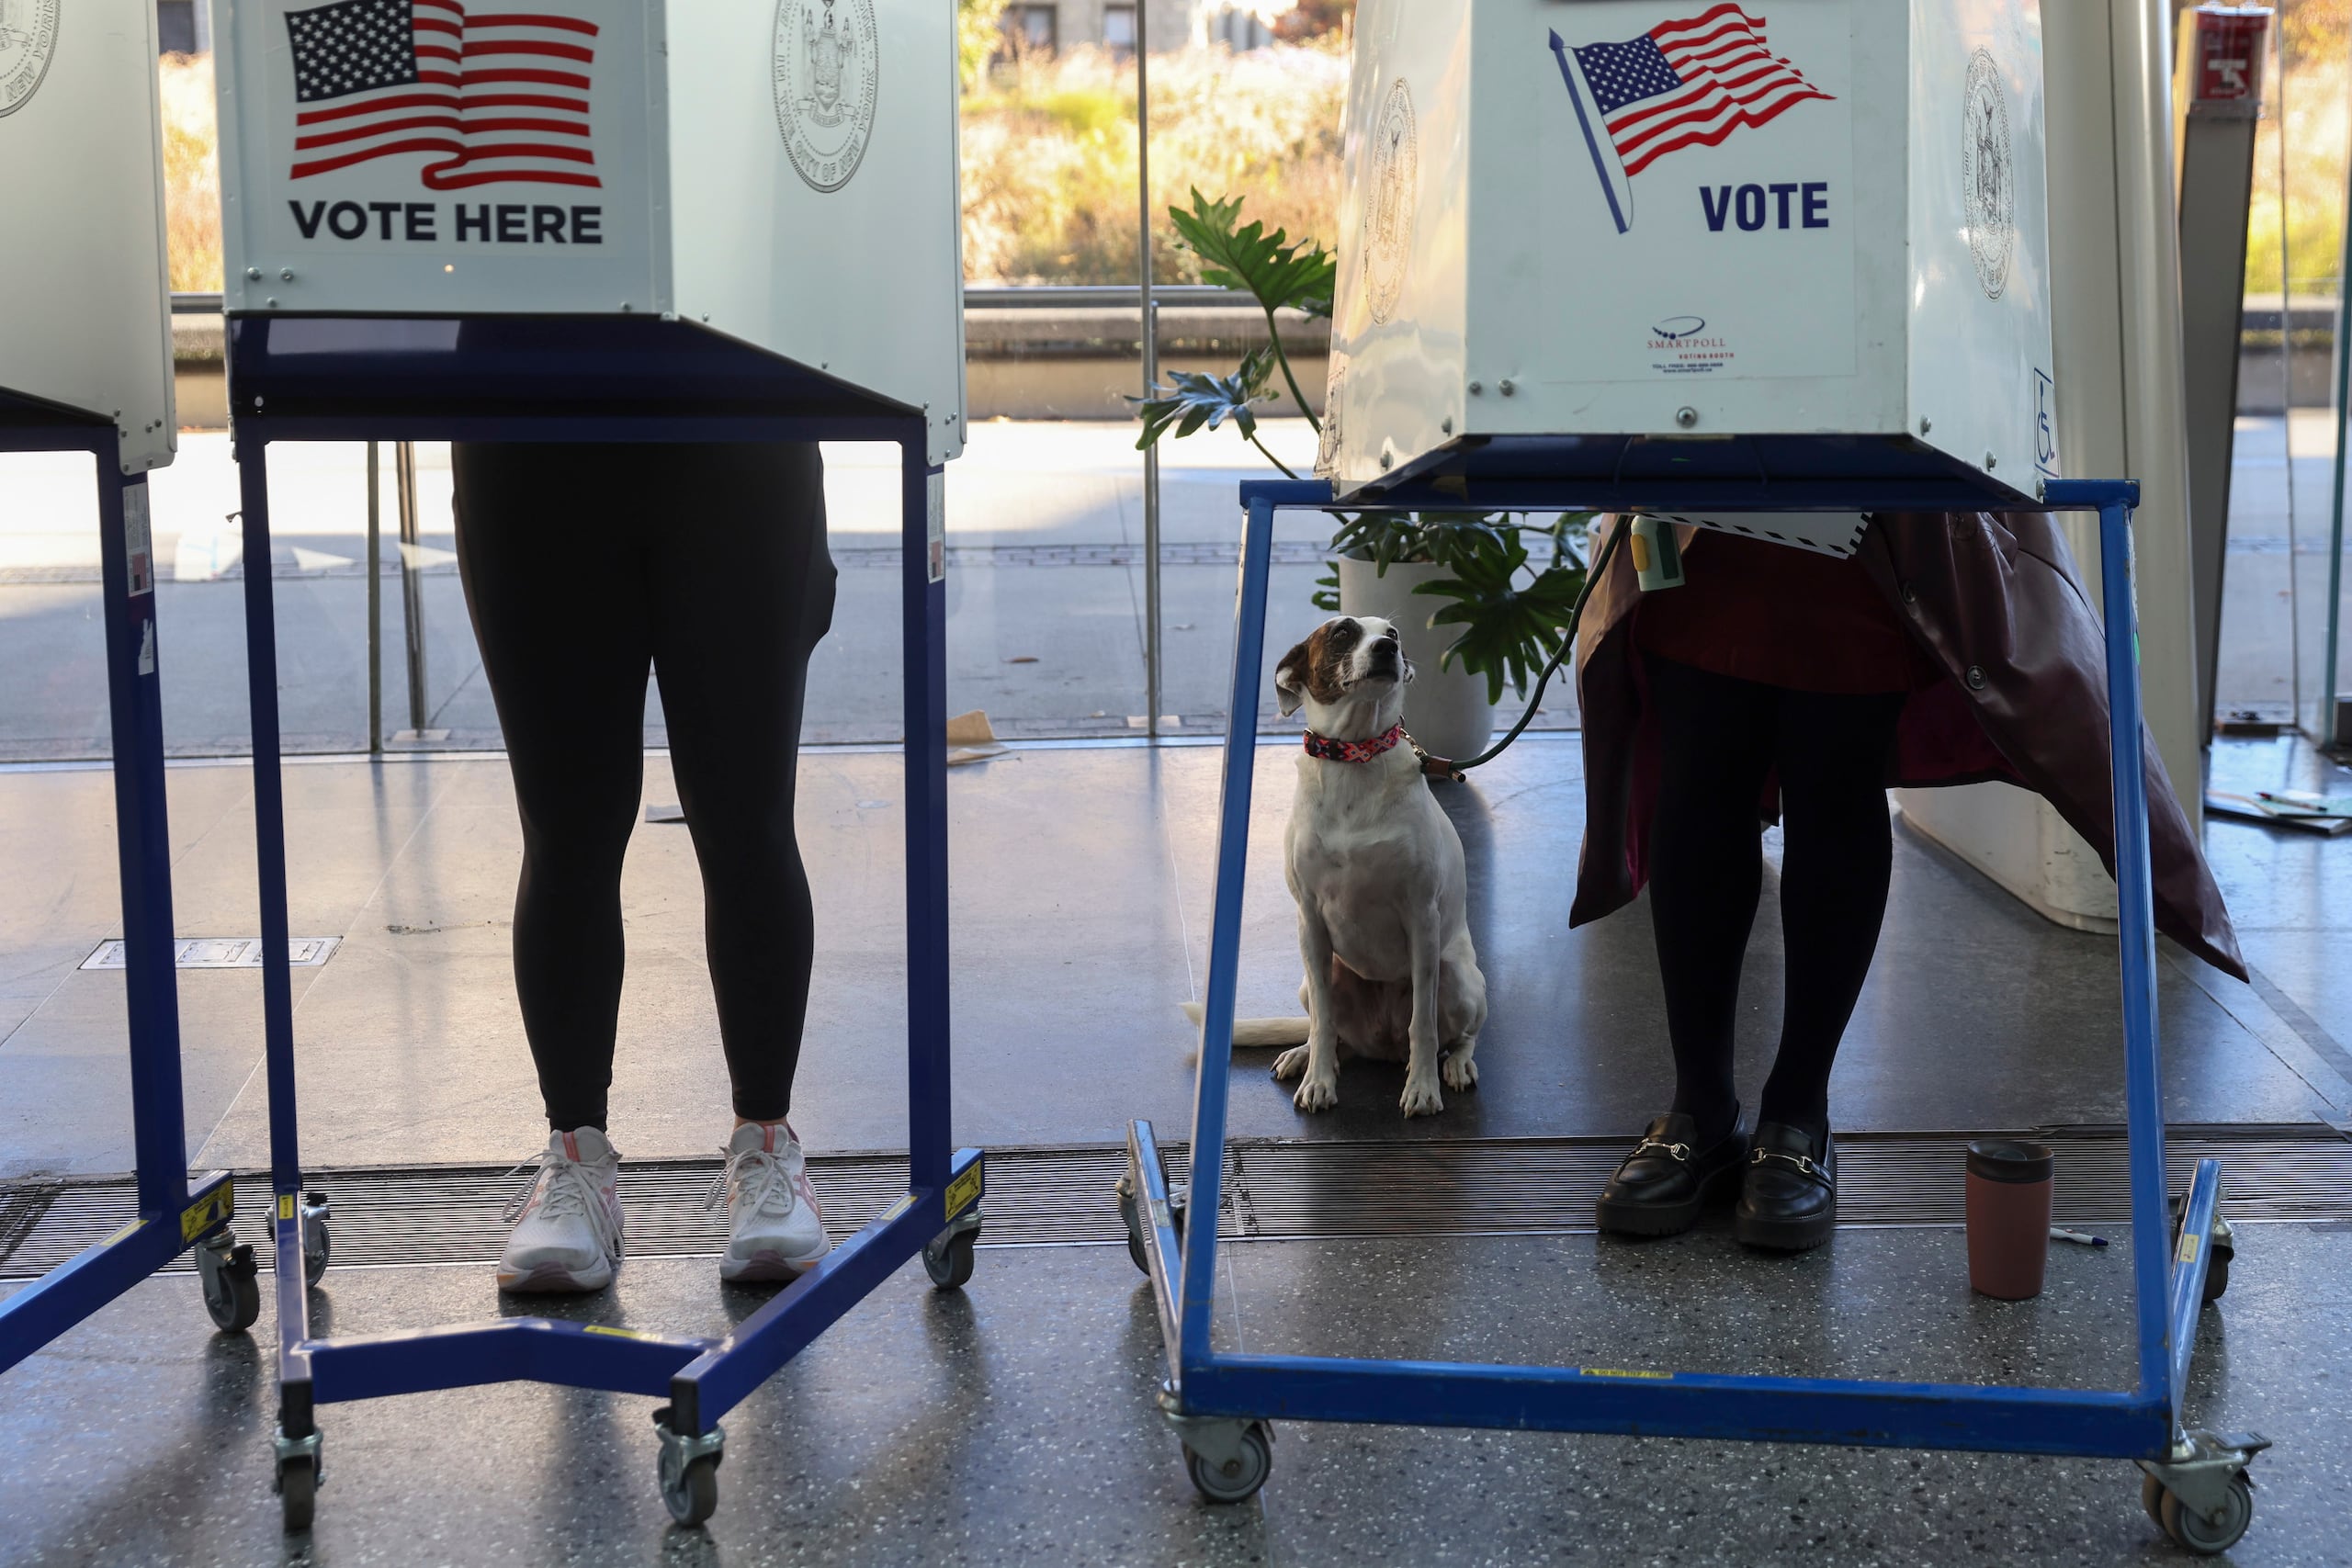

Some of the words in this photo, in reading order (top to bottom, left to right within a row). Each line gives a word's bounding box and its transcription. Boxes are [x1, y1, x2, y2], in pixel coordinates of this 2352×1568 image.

[5, 61, 36, 103] NEW
[794, 141, 820, 178] CITY
[821, 162, 837, 182] OF
[839, 133, 861, 175] NEW
[288, 200, 437, 241] VOTE
[455, 203, 603, 244] HERE
[1699, 182, 1829, 231] VOTE
[1646, 338, 1727, 349] SMARTPOLL
